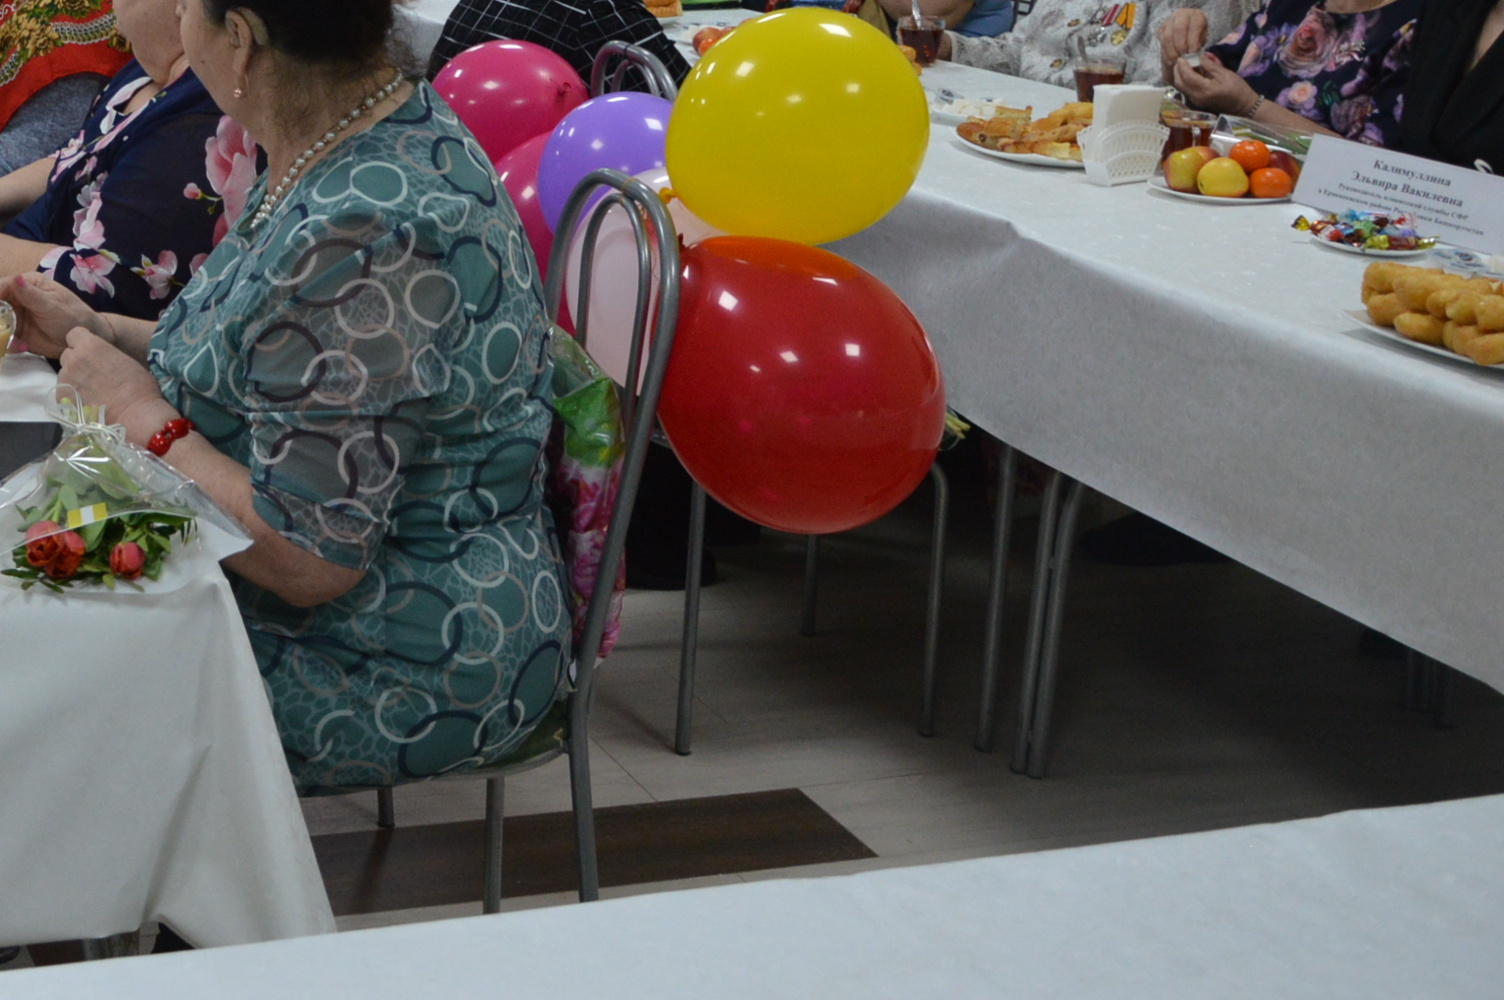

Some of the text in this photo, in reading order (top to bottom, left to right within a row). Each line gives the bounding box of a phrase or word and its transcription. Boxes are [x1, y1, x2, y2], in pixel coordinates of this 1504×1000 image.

[1373, 159, 1451, 187] Калимуллина
[1351, 171, 1464, 208] Эльвира Вакилевна
